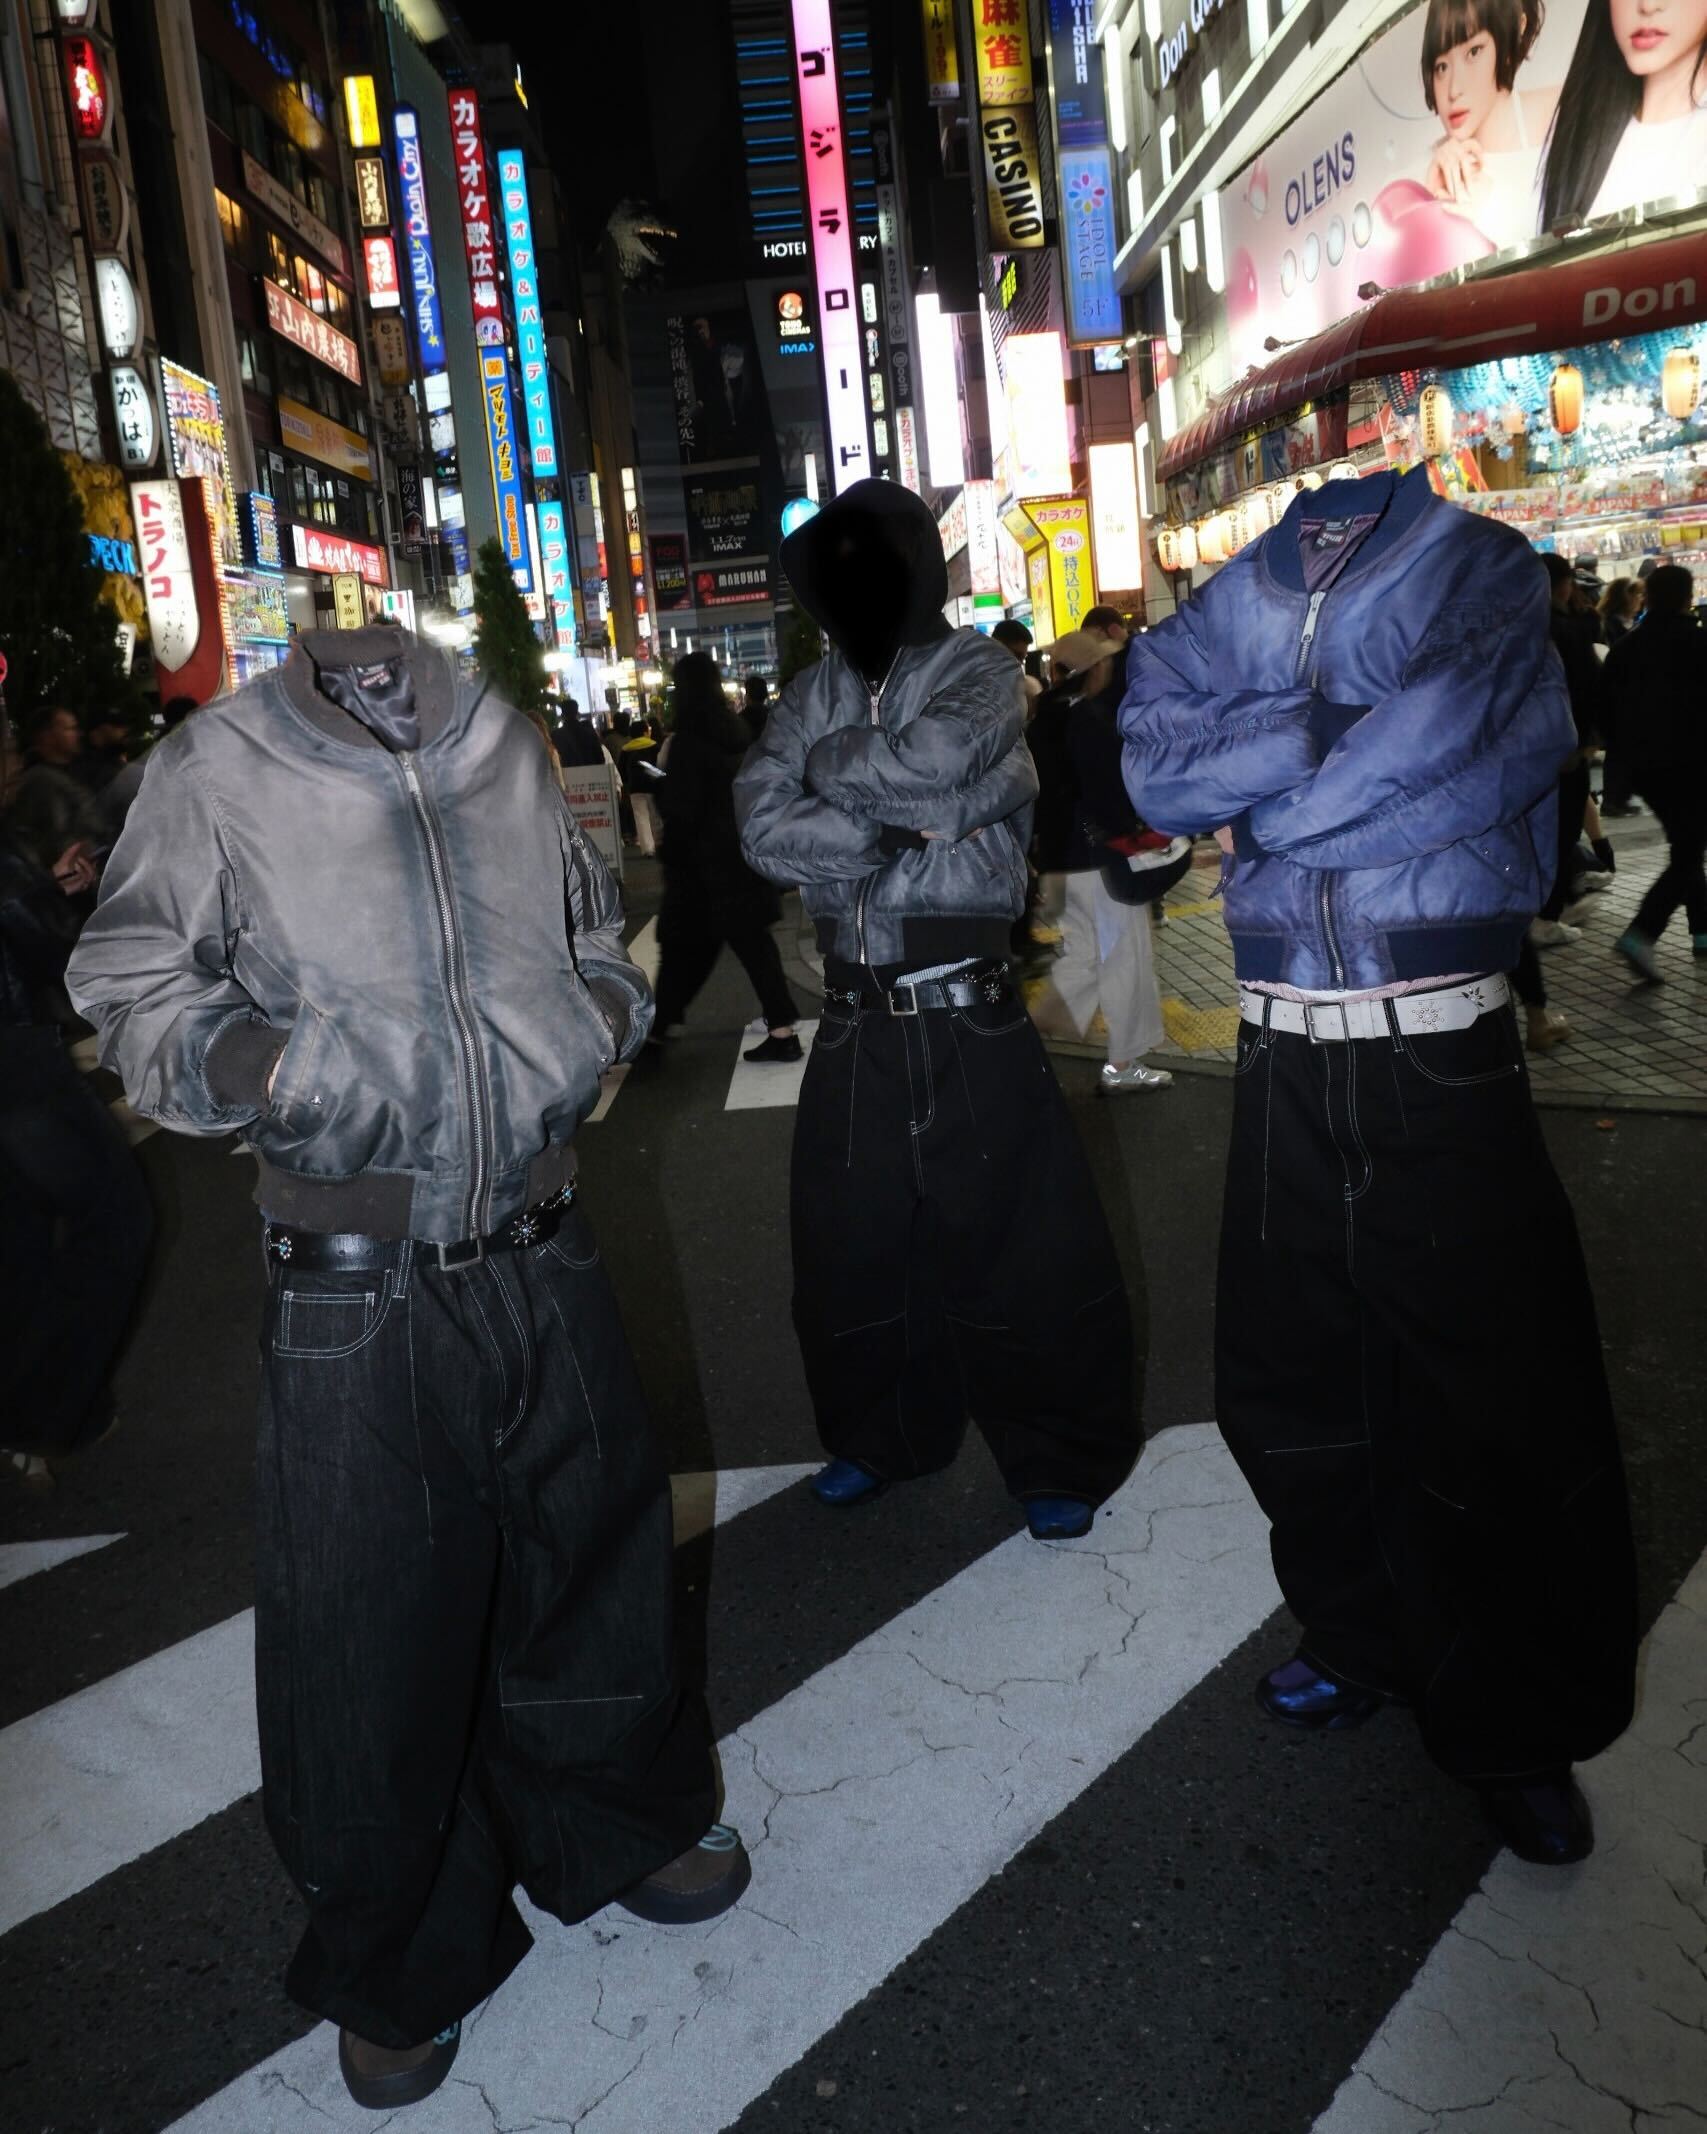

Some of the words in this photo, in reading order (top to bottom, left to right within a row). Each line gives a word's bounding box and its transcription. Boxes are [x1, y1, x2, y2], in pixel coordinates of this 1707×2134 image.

[984, 75, 1018, 88] スリー
[1159, 21, 1188, 89] Don
[453, 97, 498, 309] カラオケ歌広場
[984, 116, 1042, 240] CASINO
[1285, 130, 1355, 226] OLENS
[800, 47, 861, 466] ゴジラロード
[1077, 218, 1095, 281] STAGE
[1091, 217, 1106, 269] IDOL
[411, 250, 434, 334] SHINJUKU
[505, 162, 553, 464] カラオケ&パーティー館
[1582, 276, 1697, 328] Don
[127, 448, 145, 460] B1
[138, 492, 172, 599] トラノコ
[713, 541, 743, 553] IMAX
[1035, 507, 1085, 524] カラオケ
[718, 568, 767, 588] MARUHAN
[1133, 1068, 1148, 1080] N
